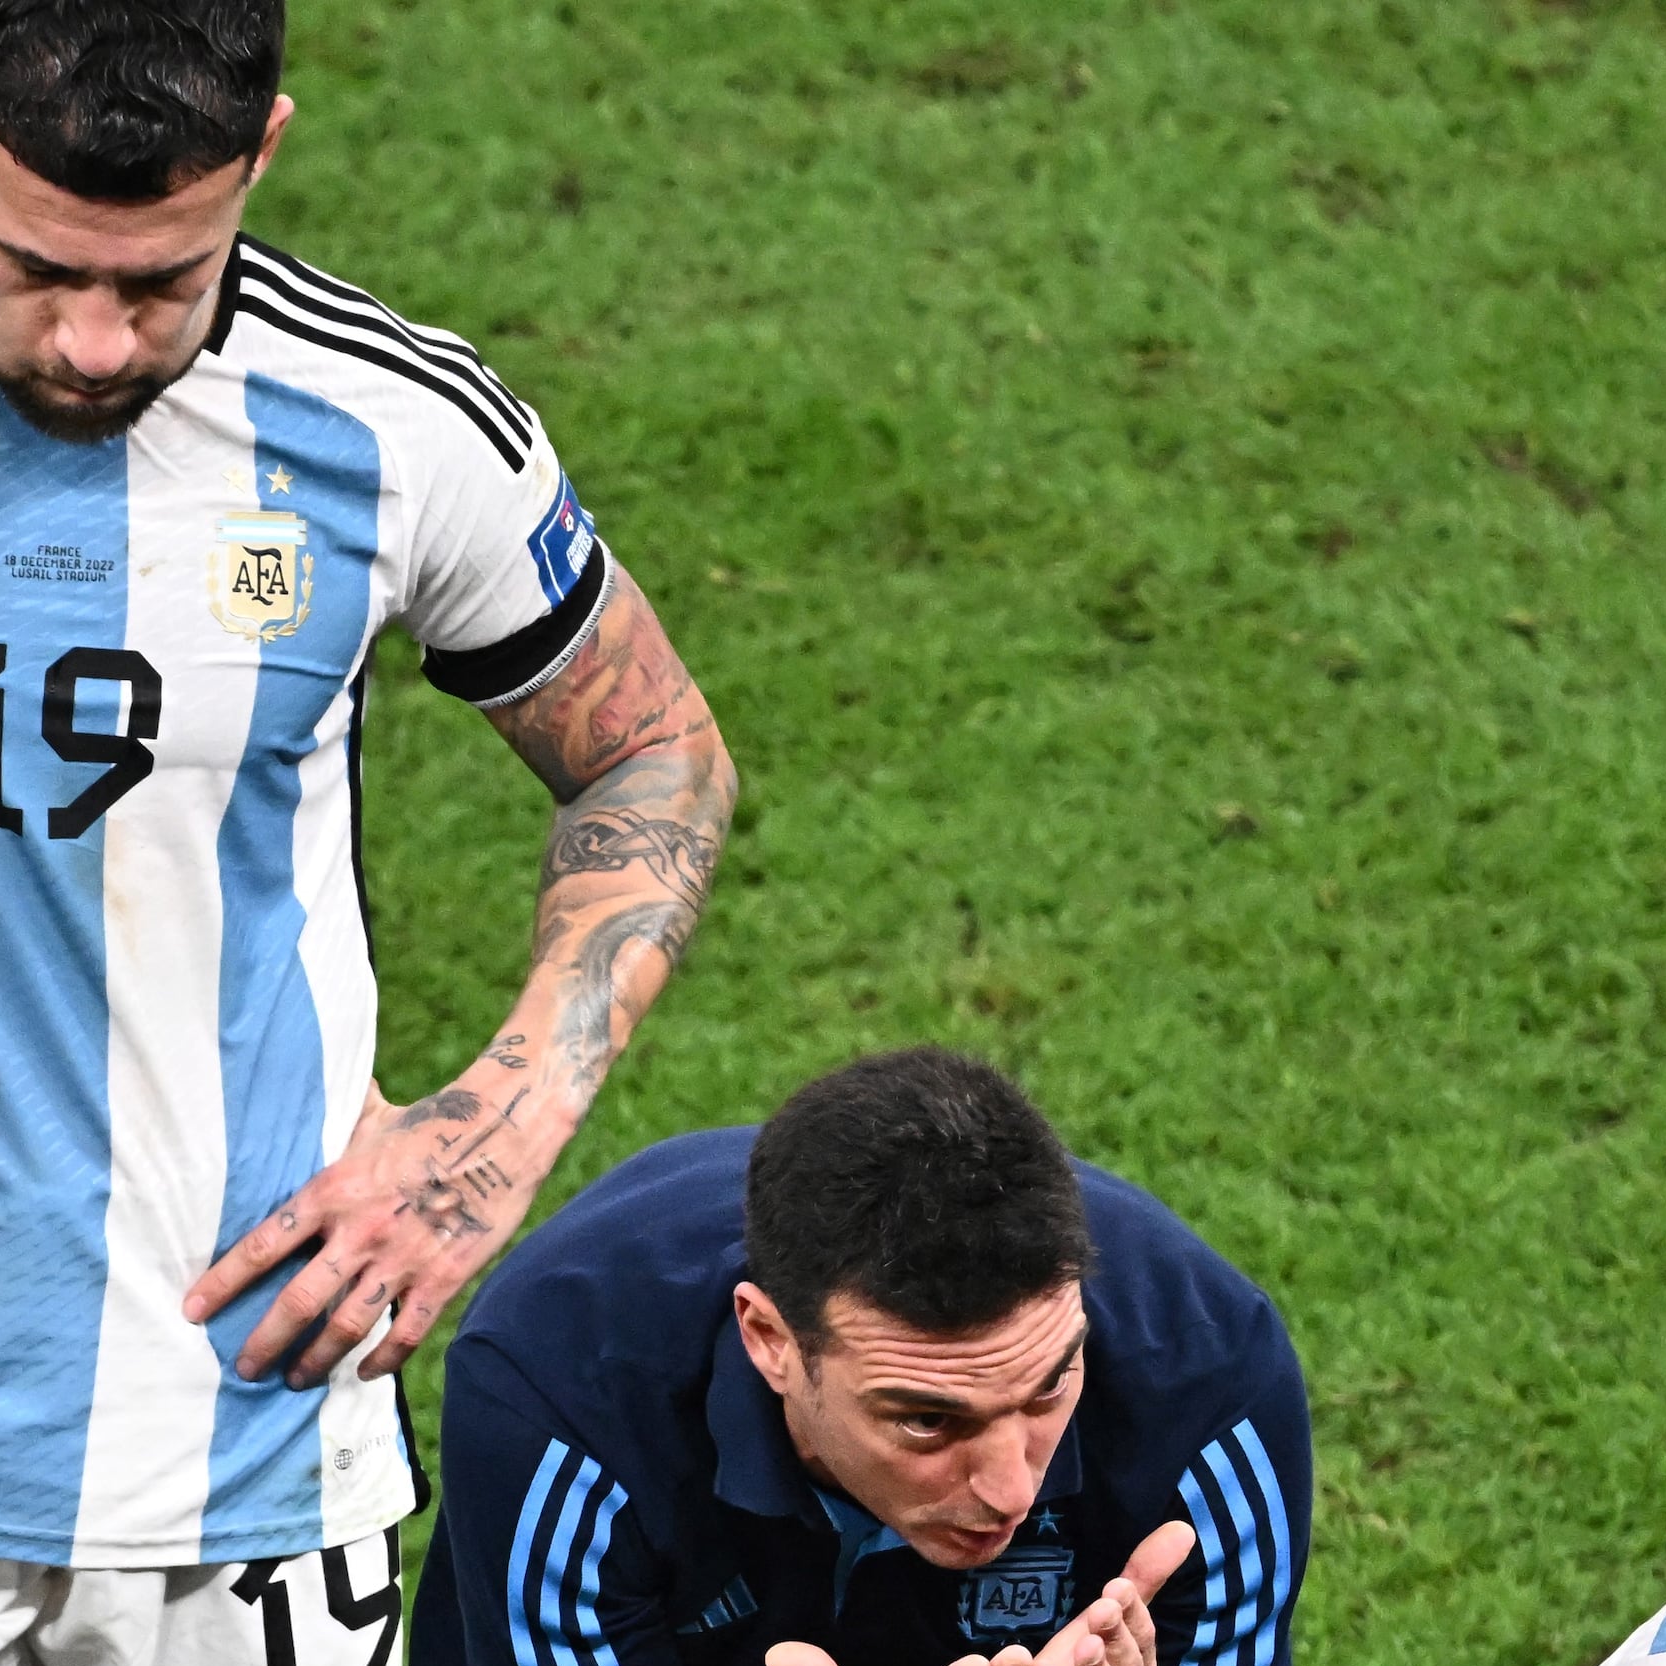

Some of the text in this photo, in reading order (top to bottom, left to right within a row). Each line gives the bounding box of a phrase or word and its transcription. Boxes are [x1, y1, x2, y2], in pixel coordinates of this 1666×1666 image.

[37, 545, 81, 558] FRANCE
[4, 555, 115, 571] 18 DECEMBER 2022
[11, 567, 107, 583] LUSAIL STADIUM
[231, 545, 289, 606] AFA
[983, 1576, 1046, 1617] AFA
